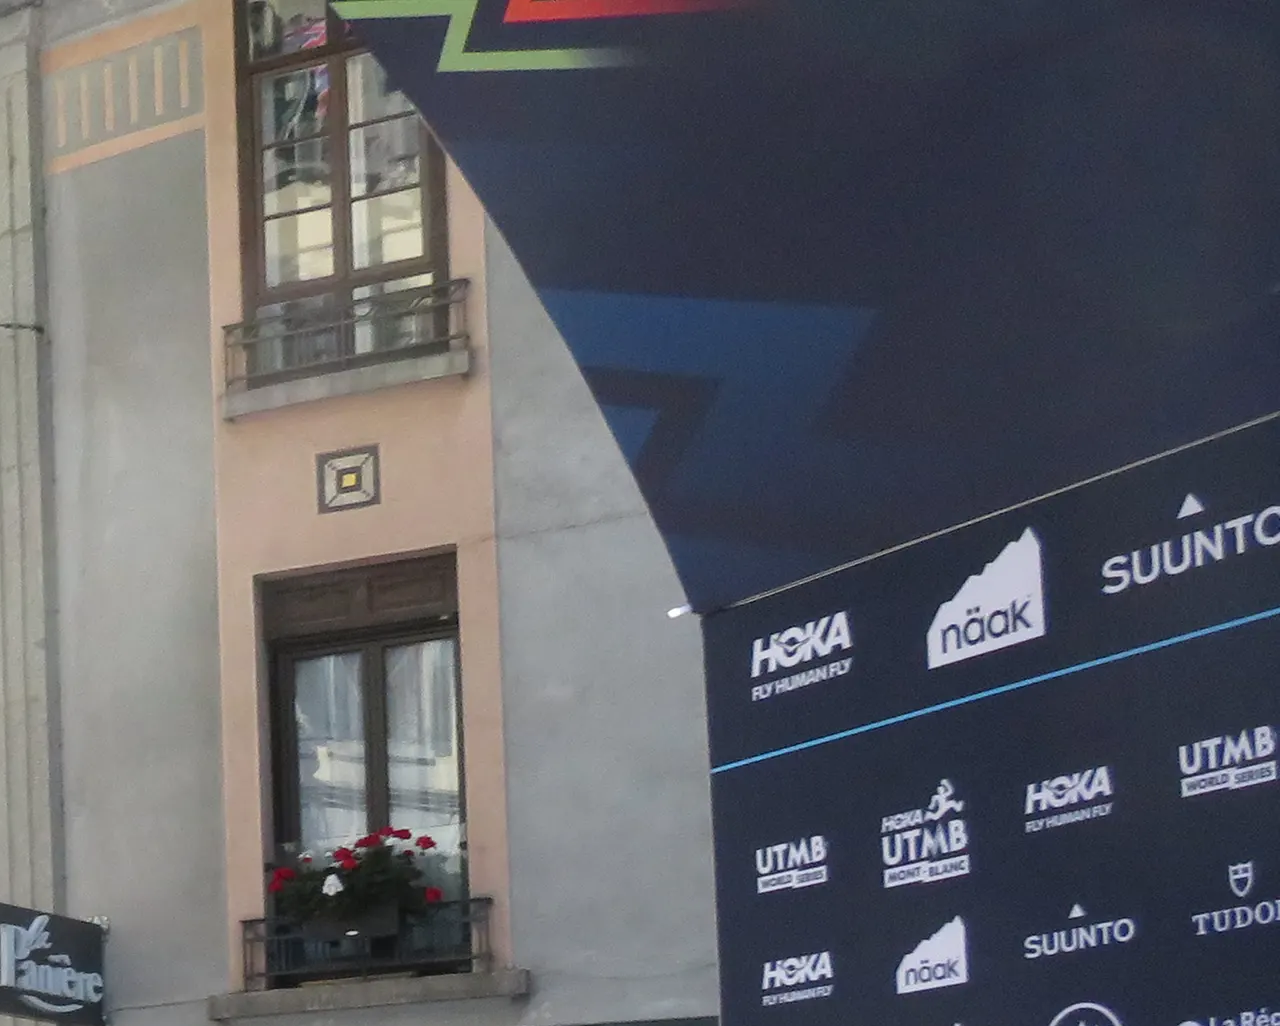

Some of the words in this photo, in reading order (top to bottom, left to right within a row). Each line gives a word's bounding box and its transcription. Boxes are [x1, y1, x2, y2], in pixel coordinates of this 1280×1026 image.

[1100, 506, 1280, 594] SUUNTO
[751, 611, 853, 679] HOKA
[940, 601, 1032, 654] näak
[752, 683, 774, 701] FLY
[775, 665, 828, 695] HUMAN
[829, 658, 853, 675] FLY
[1179, 725, 1276, 775] UTMB
[1025, 766, 1112, 815] HOKA
[1185, 774, 1228, 791] WORLD
[1233, 769, 1271, 785] SERIES
[881, 809, 923, 833] HOKA
[1025, 820, 1044, 833] FLY
[1046, 808, 1090, 829] HUMAN
[1090, 802, 1112, 818] FLY
[755, 835, 827, 875] UTMB
[882, 819, 969, 865] UTMB
[1024, 917, 1136, 959] SUUNTO
[1191, 898, 1280, 936] TUDO
[762, 950, 834, 990] HOKA
[904, 959, 960, 987] näak
